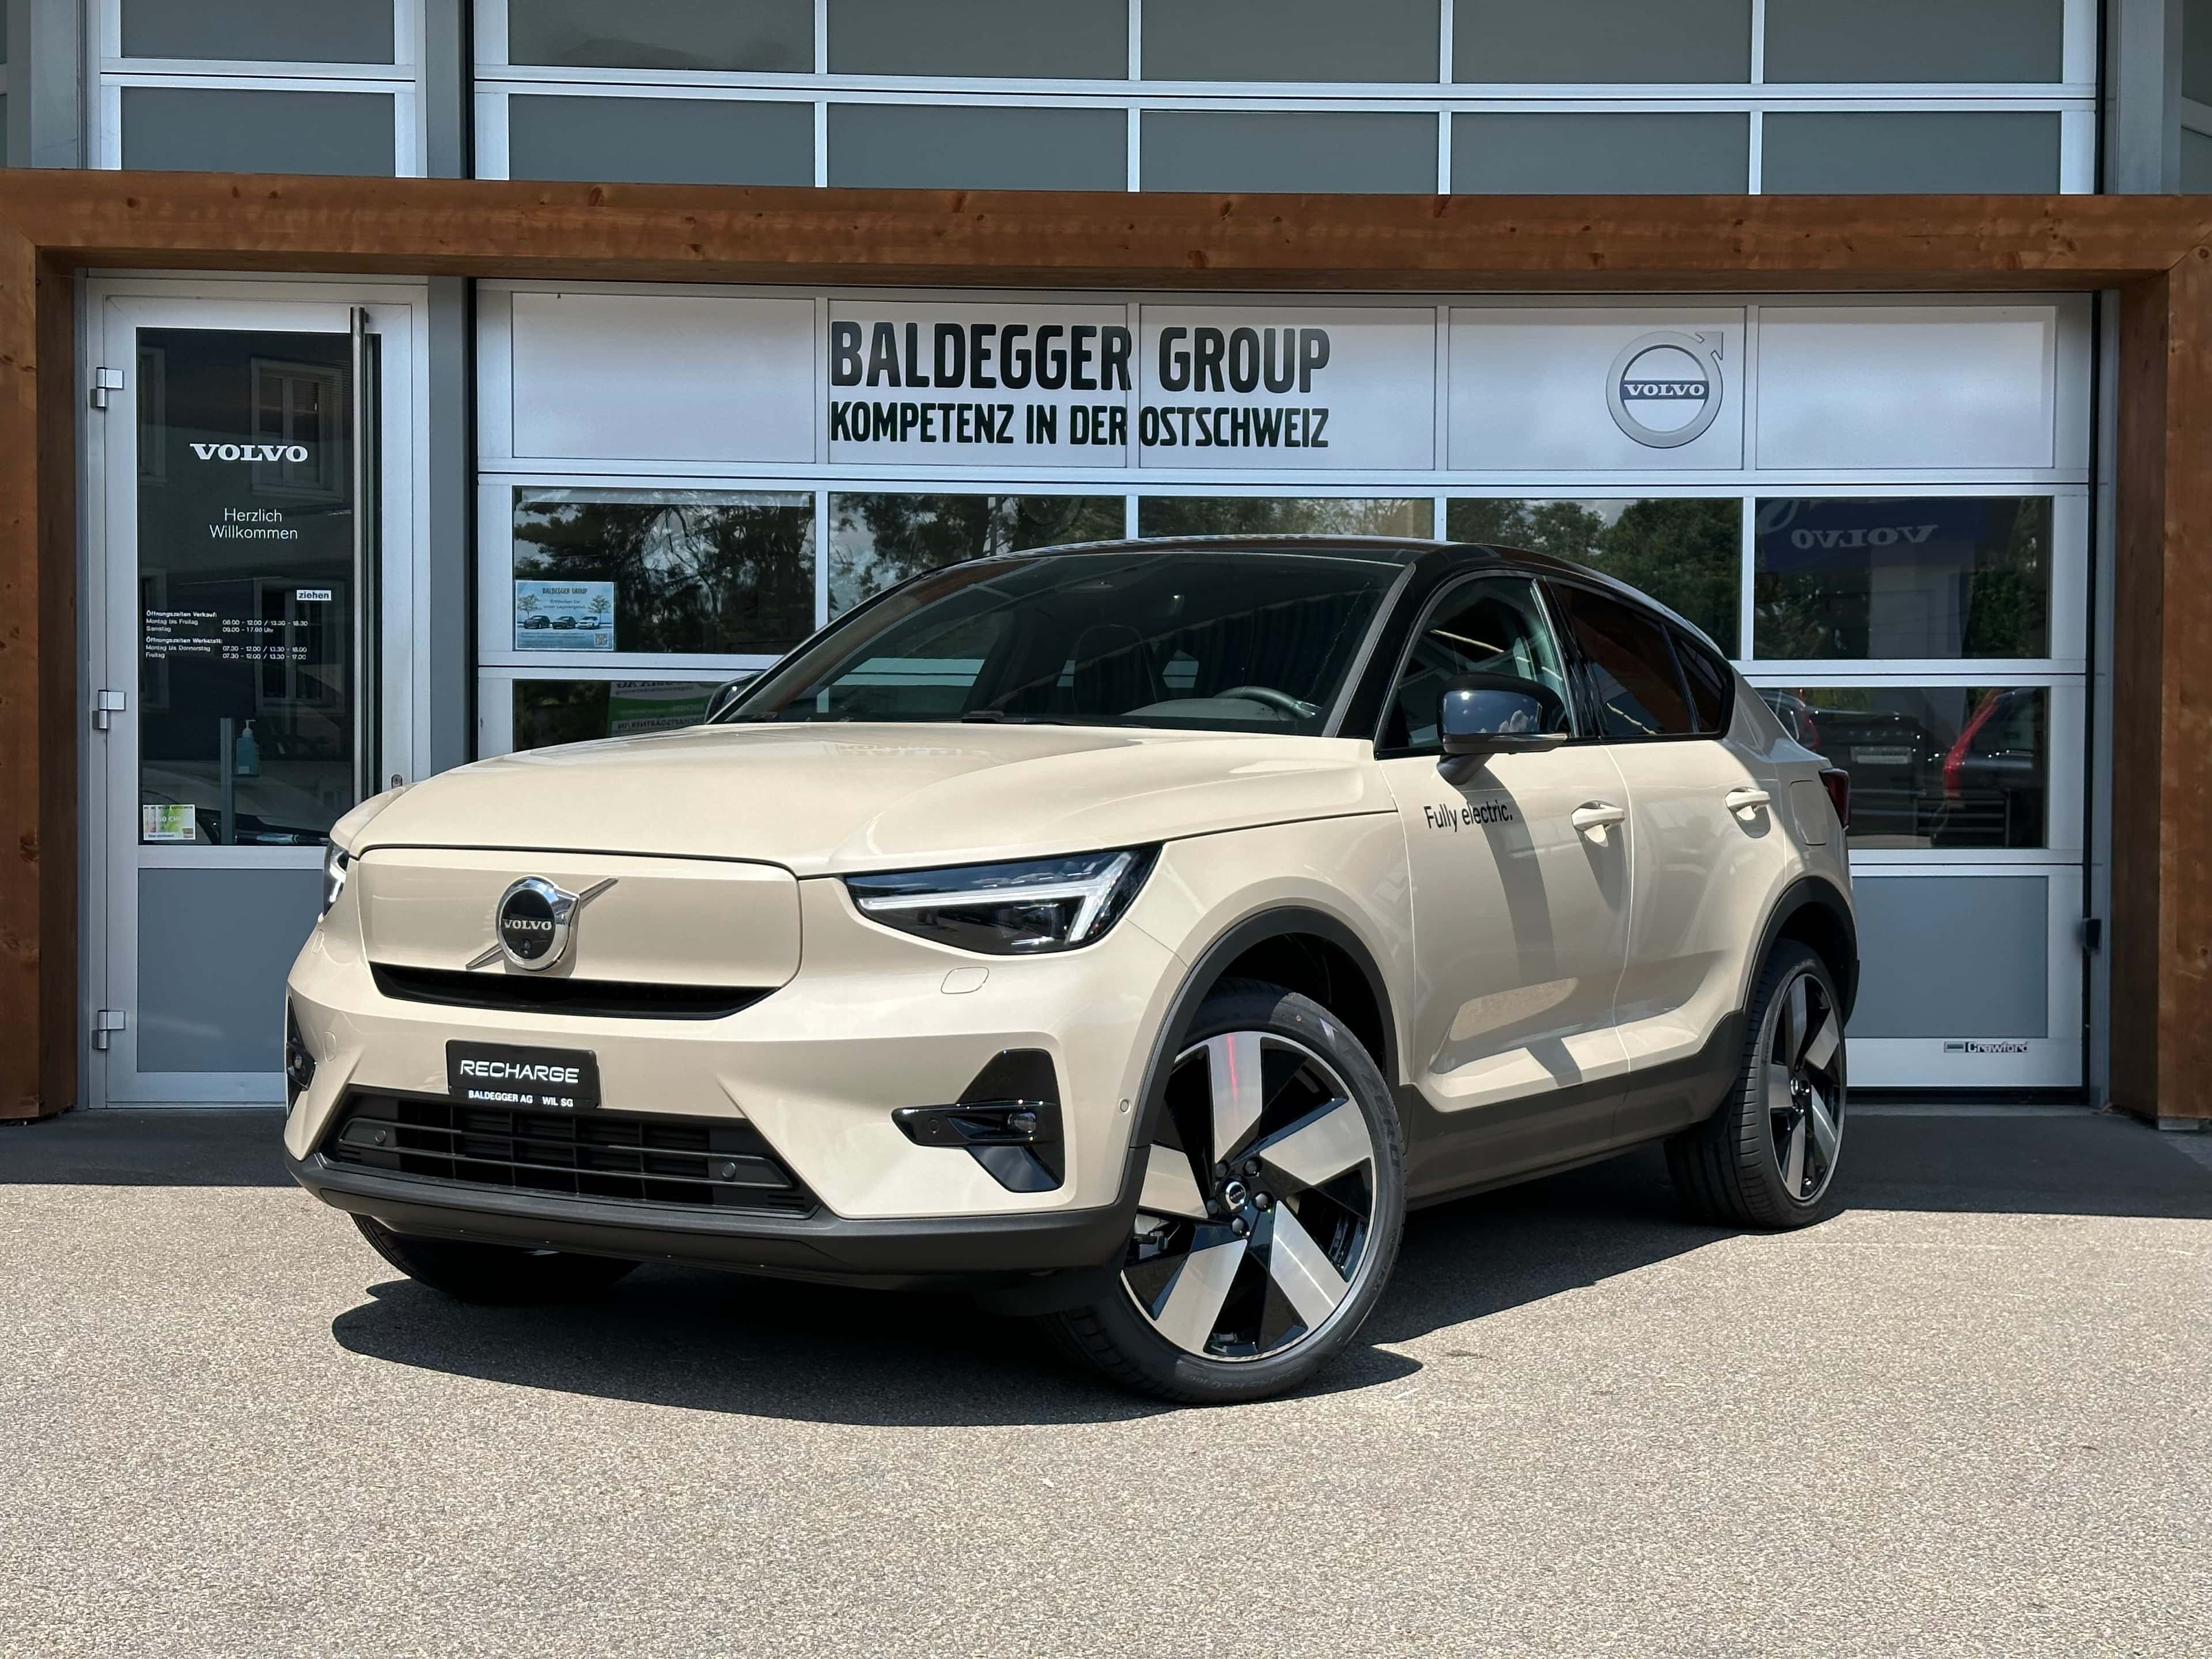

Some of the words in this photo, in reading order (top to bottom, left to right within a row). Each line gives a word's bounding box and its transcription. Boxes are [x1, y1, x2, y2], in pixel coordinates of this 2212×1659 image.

[830, 321, 1132, 392] BALDEGGER
[1158, 327, 1330, 393] GROUP
[1624, 384, 1705, 396] VOLVO
[830, 400, 1014, 445] KOMPETENZ
[1025, 404, 1056, 445] IN
[1070, 404, 1127, 446] DER
[1140, 406, 1329, 448] OSTSCHWEIZ
[190, 443, 308, 462] VOLVO
[224, 508, 282, 522] Herzlich
[209, 524, 298, 539] Willkommen
[298, 590, 329, 599] ziehen
[1423, 804, 1457, 832] Fully
[1461, 800, 1513, 825] electric.
[502, 918, 552, 930] VOLVO
[460, 1059, 579, 1084] RECHARGE
[468, 1090, 518, 1102] BALDEGGER
[520, 1094, 533, 1104] AG
[543, 1096, 558, 1106] WIL
[561, 1098, 574, 1107] SG
